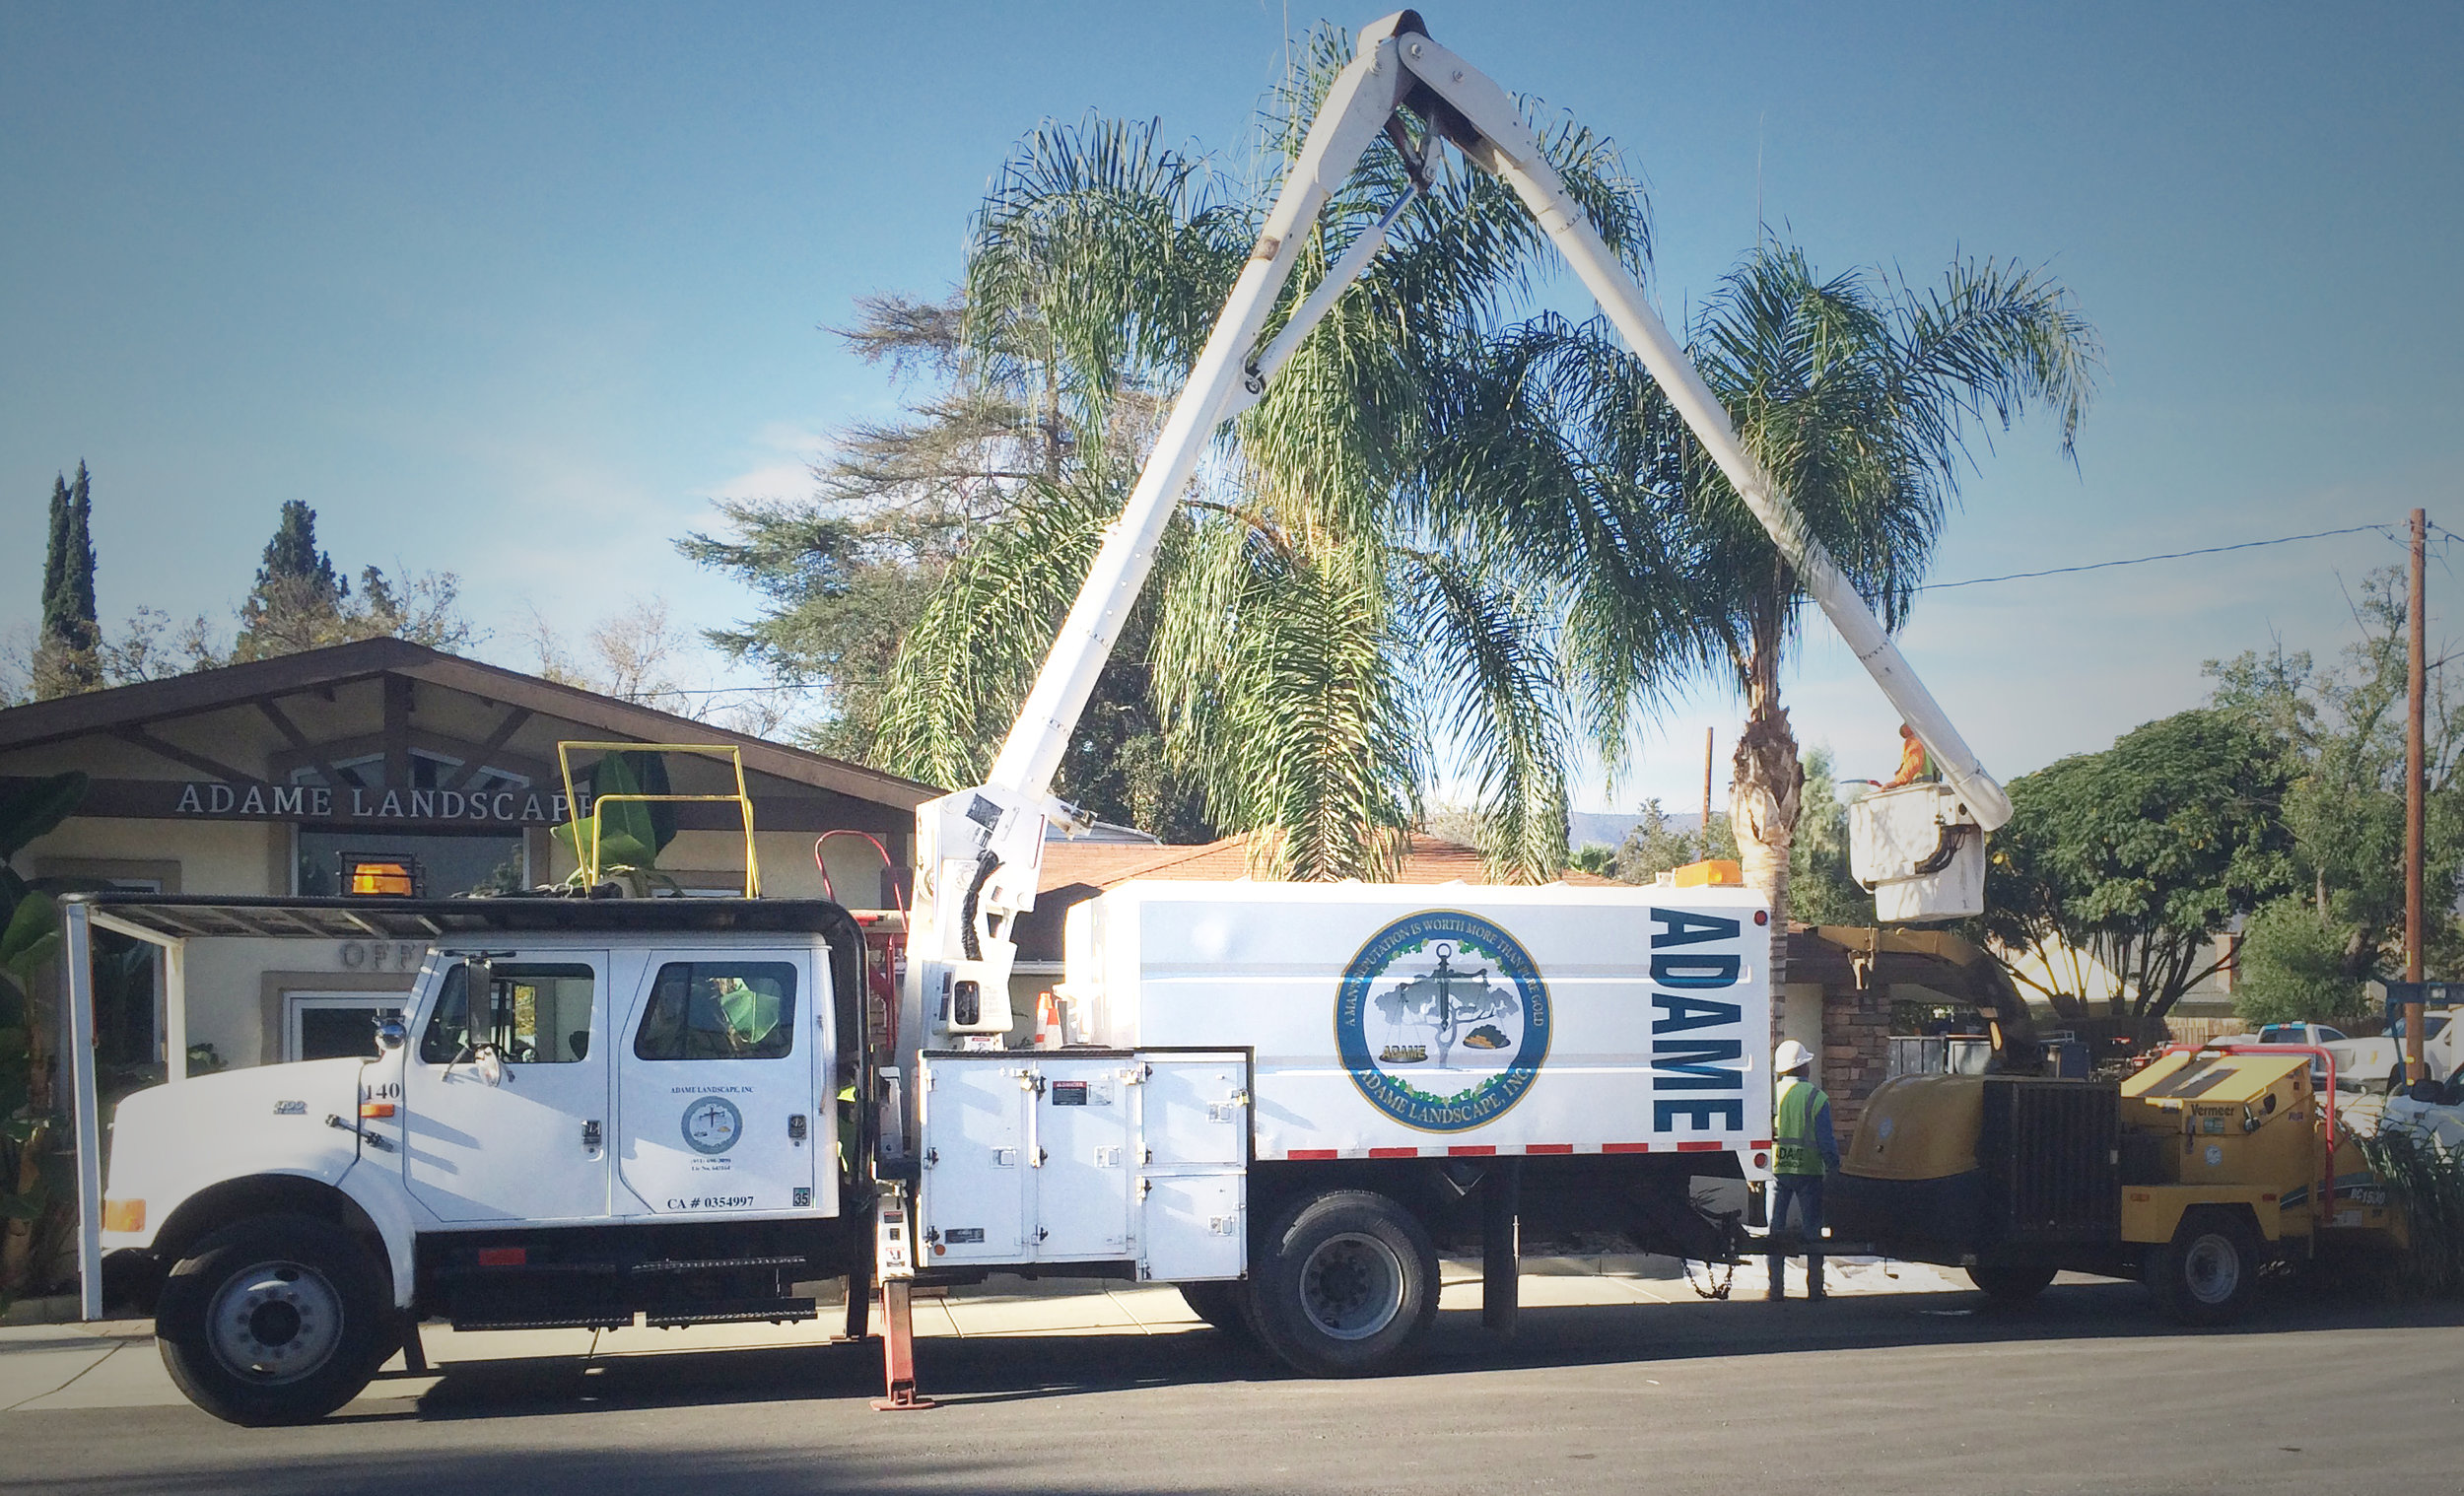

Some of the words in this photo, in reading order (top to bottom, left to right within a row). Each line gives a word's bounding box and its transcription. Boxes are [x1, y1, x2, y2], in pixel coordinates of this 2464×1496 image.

[175, 784, 332, 816] ADAME
[339, 942, 430, 969] OFF
[1345, 1016, 1356, 1027] A
[1410, 922, 1422, 935] IS
[1422, 918, 1465, 932] WORTH
[1466, 922, 1498, 945] MORE
[1497, 938, 1525, 968] THAN
[1532, 994, 1544, 1027] GOLD
[1649, 908, 1743, 1132] ADAME
[1381, 1045, 1427, 1059] ADAME
[366, 1083, 400, 1100] 140
[1358, 1068, 1406, 1115] ADAME
[1409, 1094, 1506, 1123] LANDSCAPE,
[2191, 1103, 2234, 1117] Vermeer
[667, 1198, 687, 1210] CA
[690, 1196, 702, 1208] #
[704, 1195, 754, 1208] 0354997
[793, 1192, 809, 1205] 35
